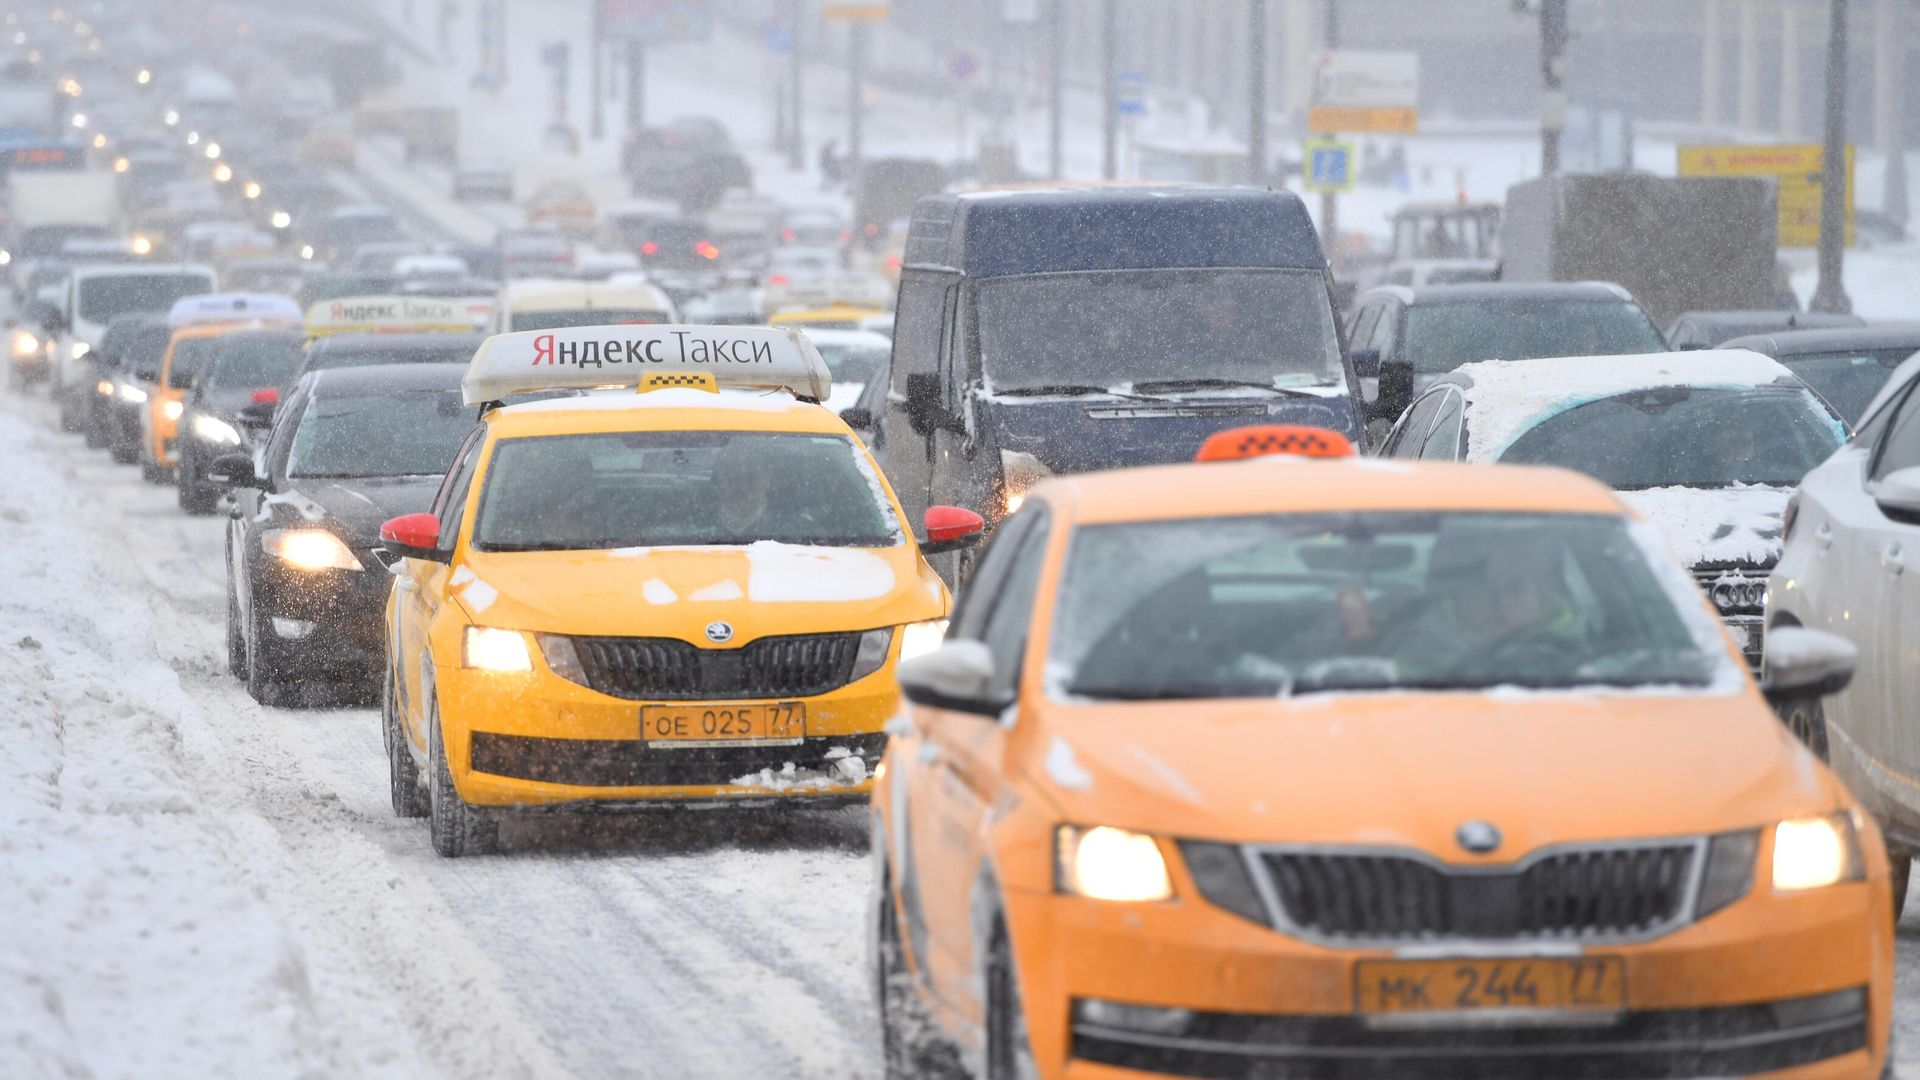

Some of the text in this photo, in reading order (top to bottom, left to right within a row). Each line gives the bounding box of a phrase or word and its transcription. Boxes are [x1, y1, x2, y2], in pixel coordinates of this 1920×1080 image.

[330, 302, 397, 321] Яндекс
[532, 332, 773, 368] Яндекс Такси
[702, 709, 751, 735] 025
[769, 706, 793, 726] 77
[1455, 965, 1538, 1008] 244
[1567, 959, 1607, 993] 77
